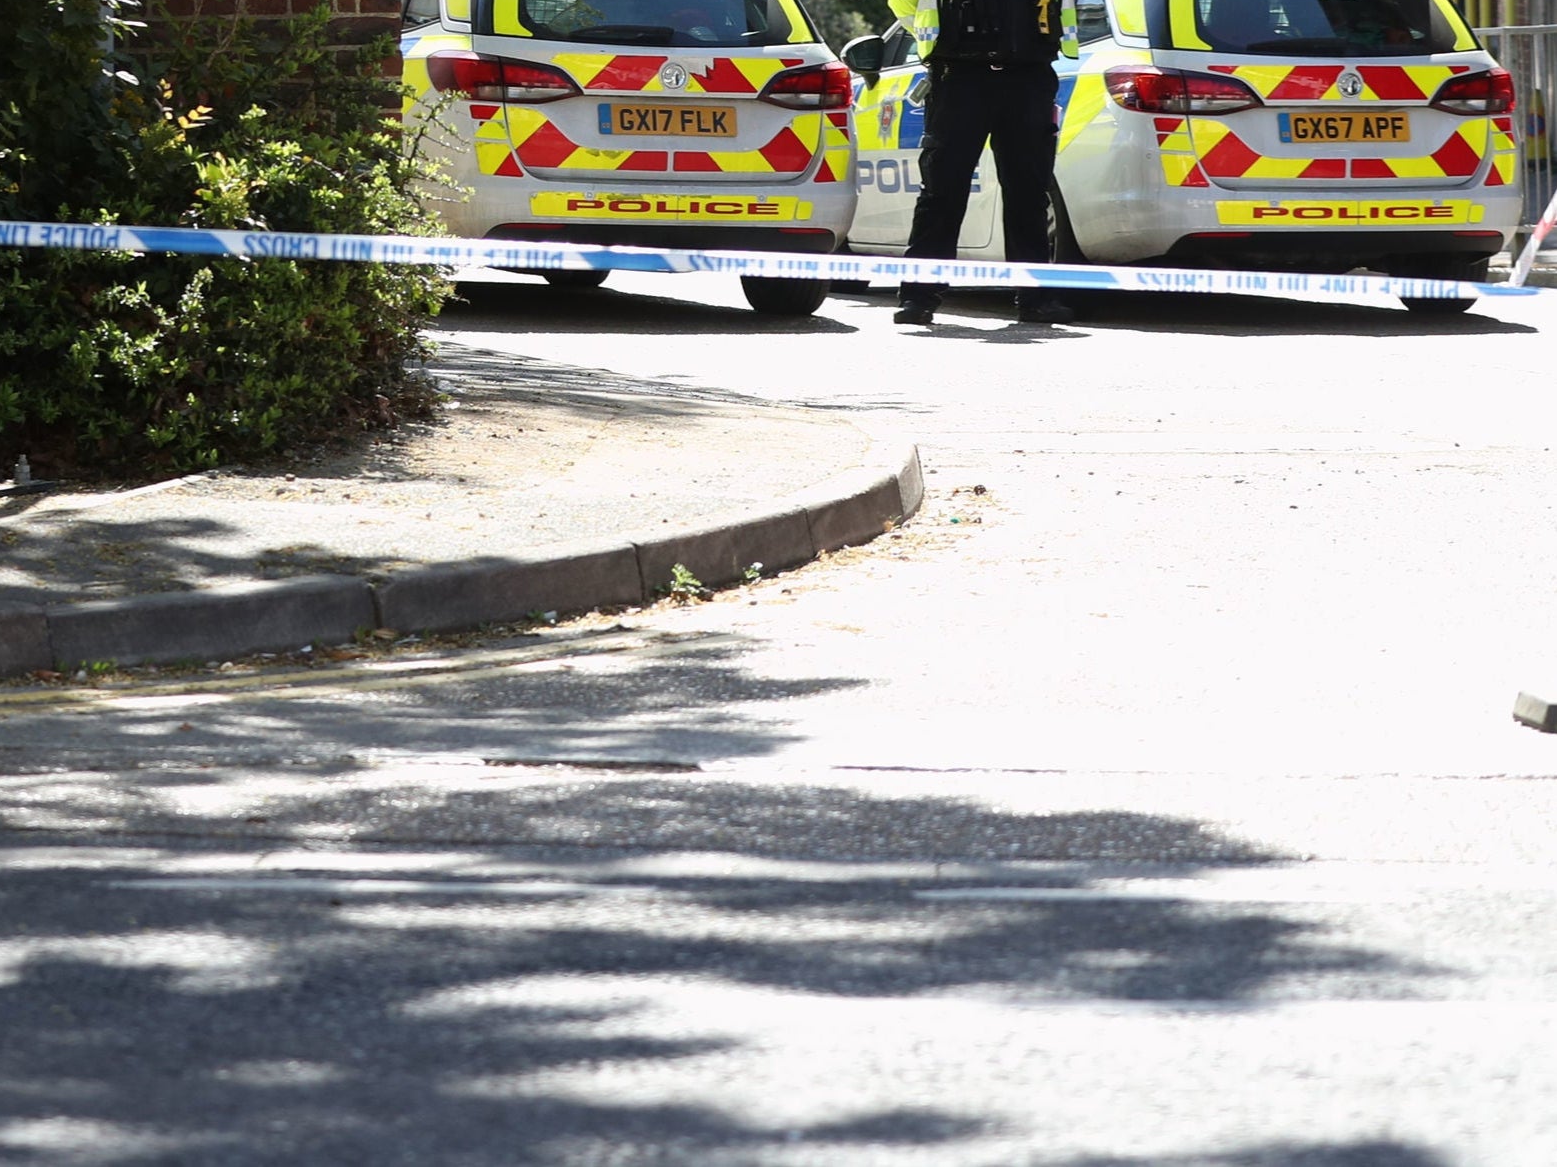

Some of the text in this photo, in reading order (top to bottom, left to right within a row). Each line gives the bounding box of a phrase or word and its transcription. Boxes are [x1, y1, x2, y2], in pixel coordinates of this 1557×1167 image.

[619, 108, 728, 134] GX17 FLK
[1294, 117, 1404, 139] GX67 APF
[567, 199, 780, 215] POLICE
[1252, 206, 1455, 220] POLICE
[42, 225, 121, 249] POLICE
[243, 235, 319, 259] CROSS
